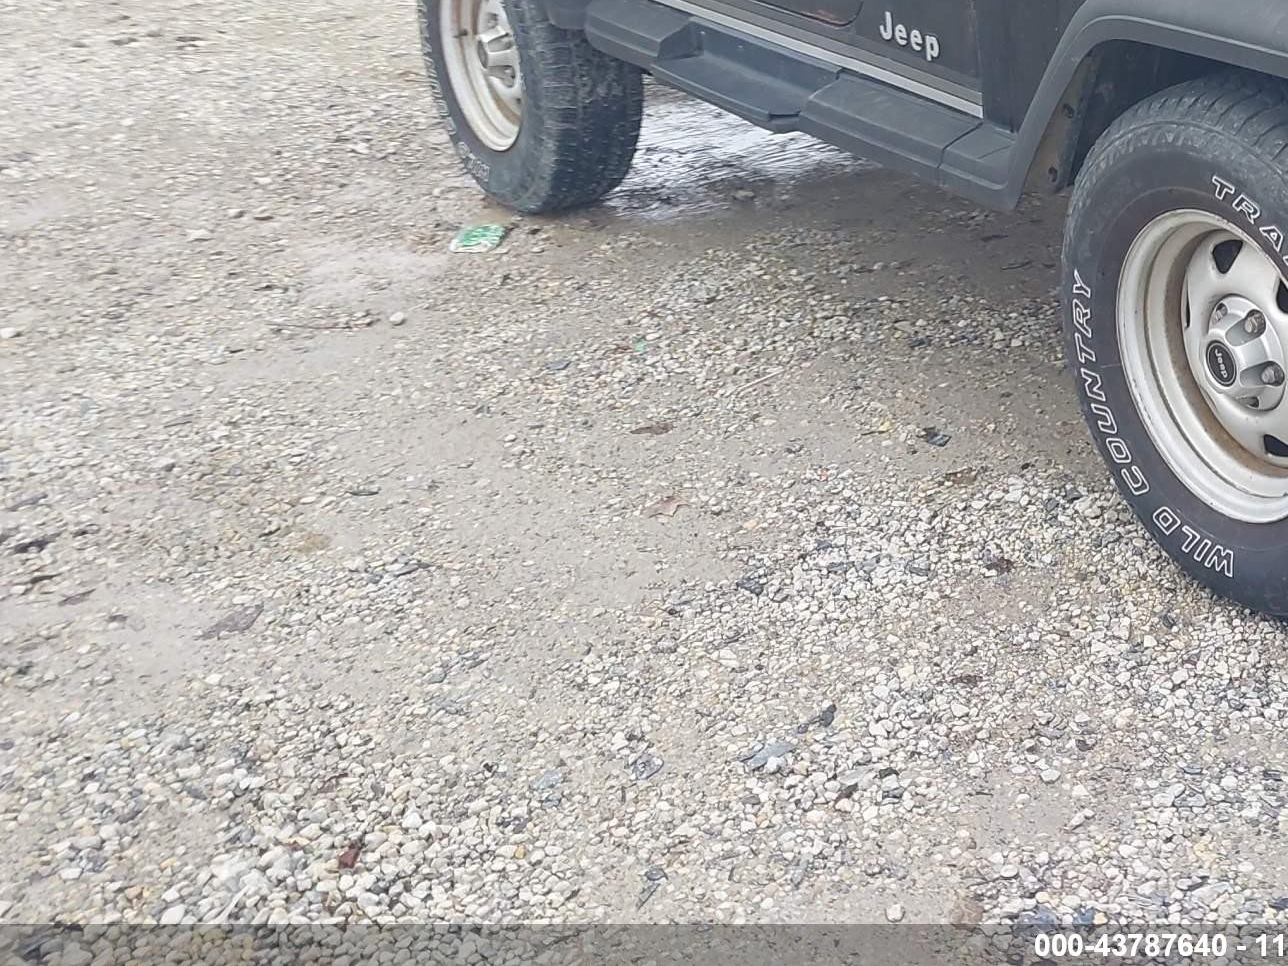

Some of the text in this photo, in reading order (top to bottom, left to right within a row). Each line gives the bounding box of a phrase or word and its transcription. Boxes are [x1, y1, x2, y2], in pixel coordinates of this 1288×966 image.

[879, 10, 941, 62] Jeep
[1214, 347, 1229, 380] Jeep
[1073, 269, 1234, 578] WILD COUNTRY
